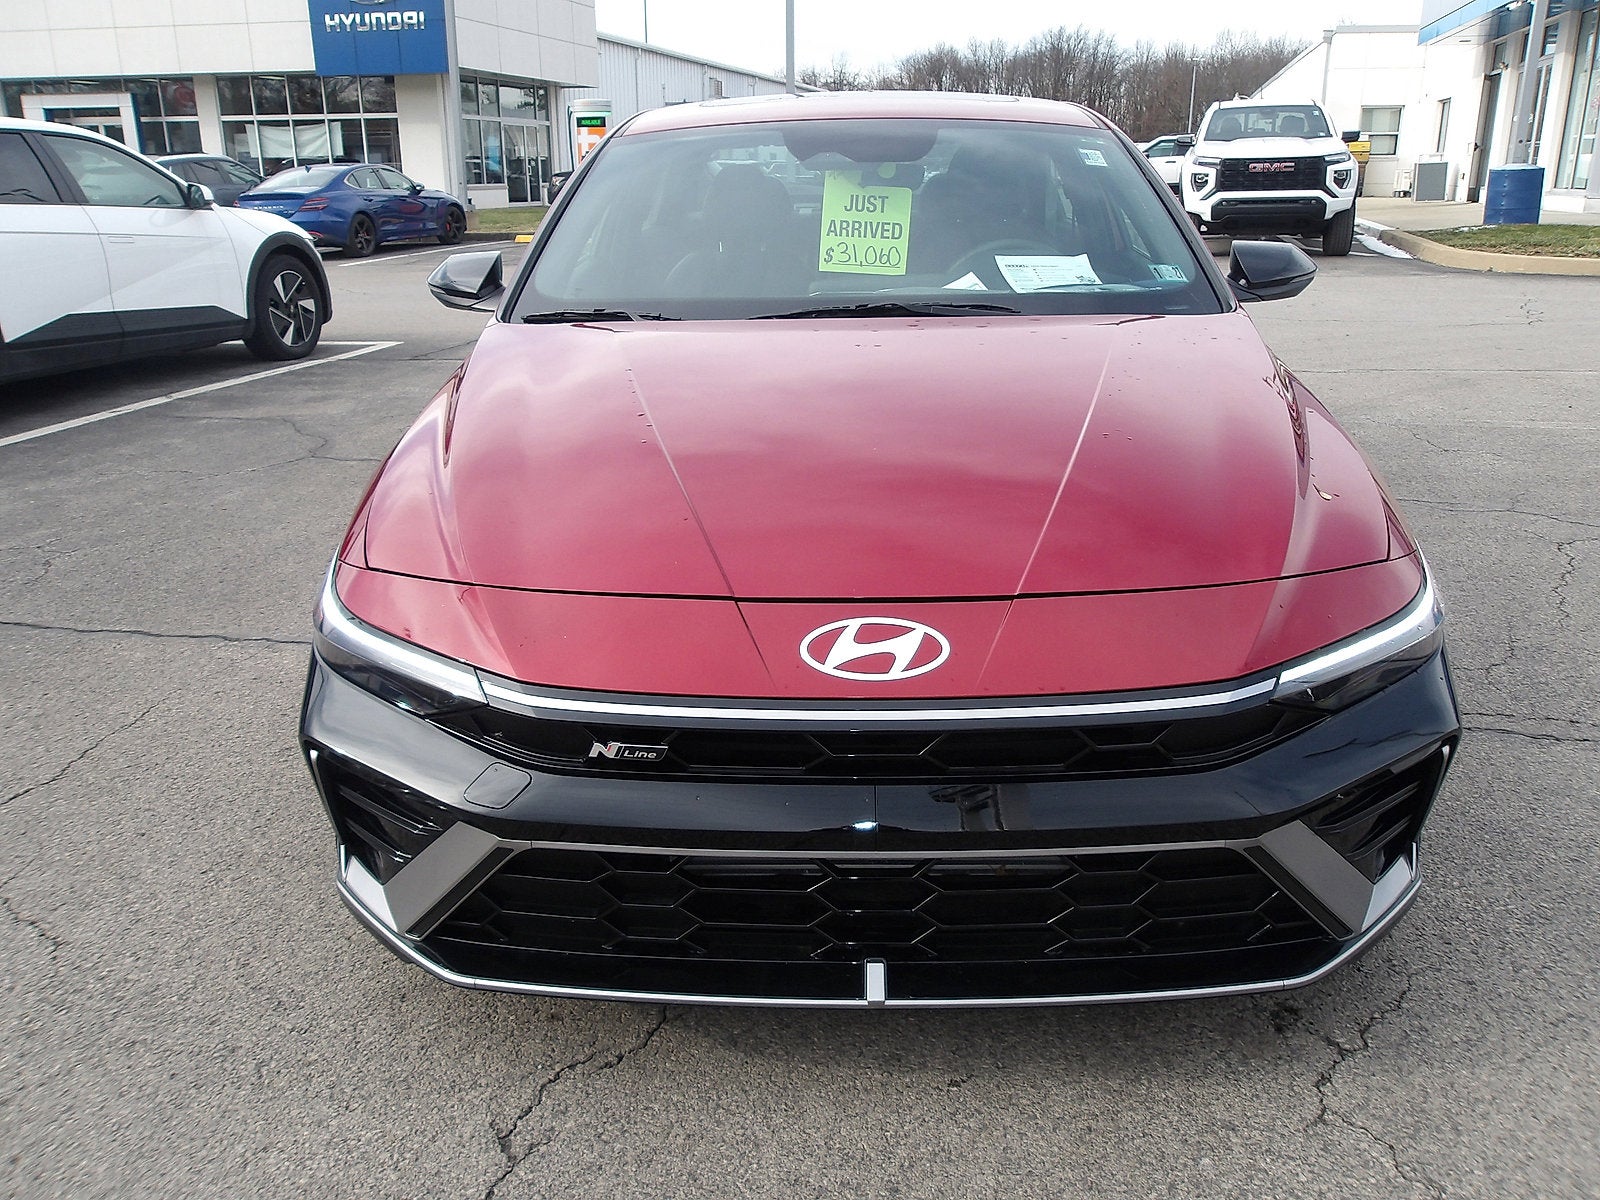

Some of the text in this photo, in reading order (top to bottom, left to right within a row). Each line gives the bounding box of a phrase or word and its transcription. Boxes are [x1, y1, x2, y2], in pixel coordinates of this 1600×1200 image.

[324, 11, 425, 32] HYUNDAI
[1248, 162, 1295, 173] GMC
[843, 194, 889, 214] JUST
[826, 219, 903, 240] ARRIVED
[823, 241, 902, 268] $31,060
[588, 742, 657, 759] N Line
